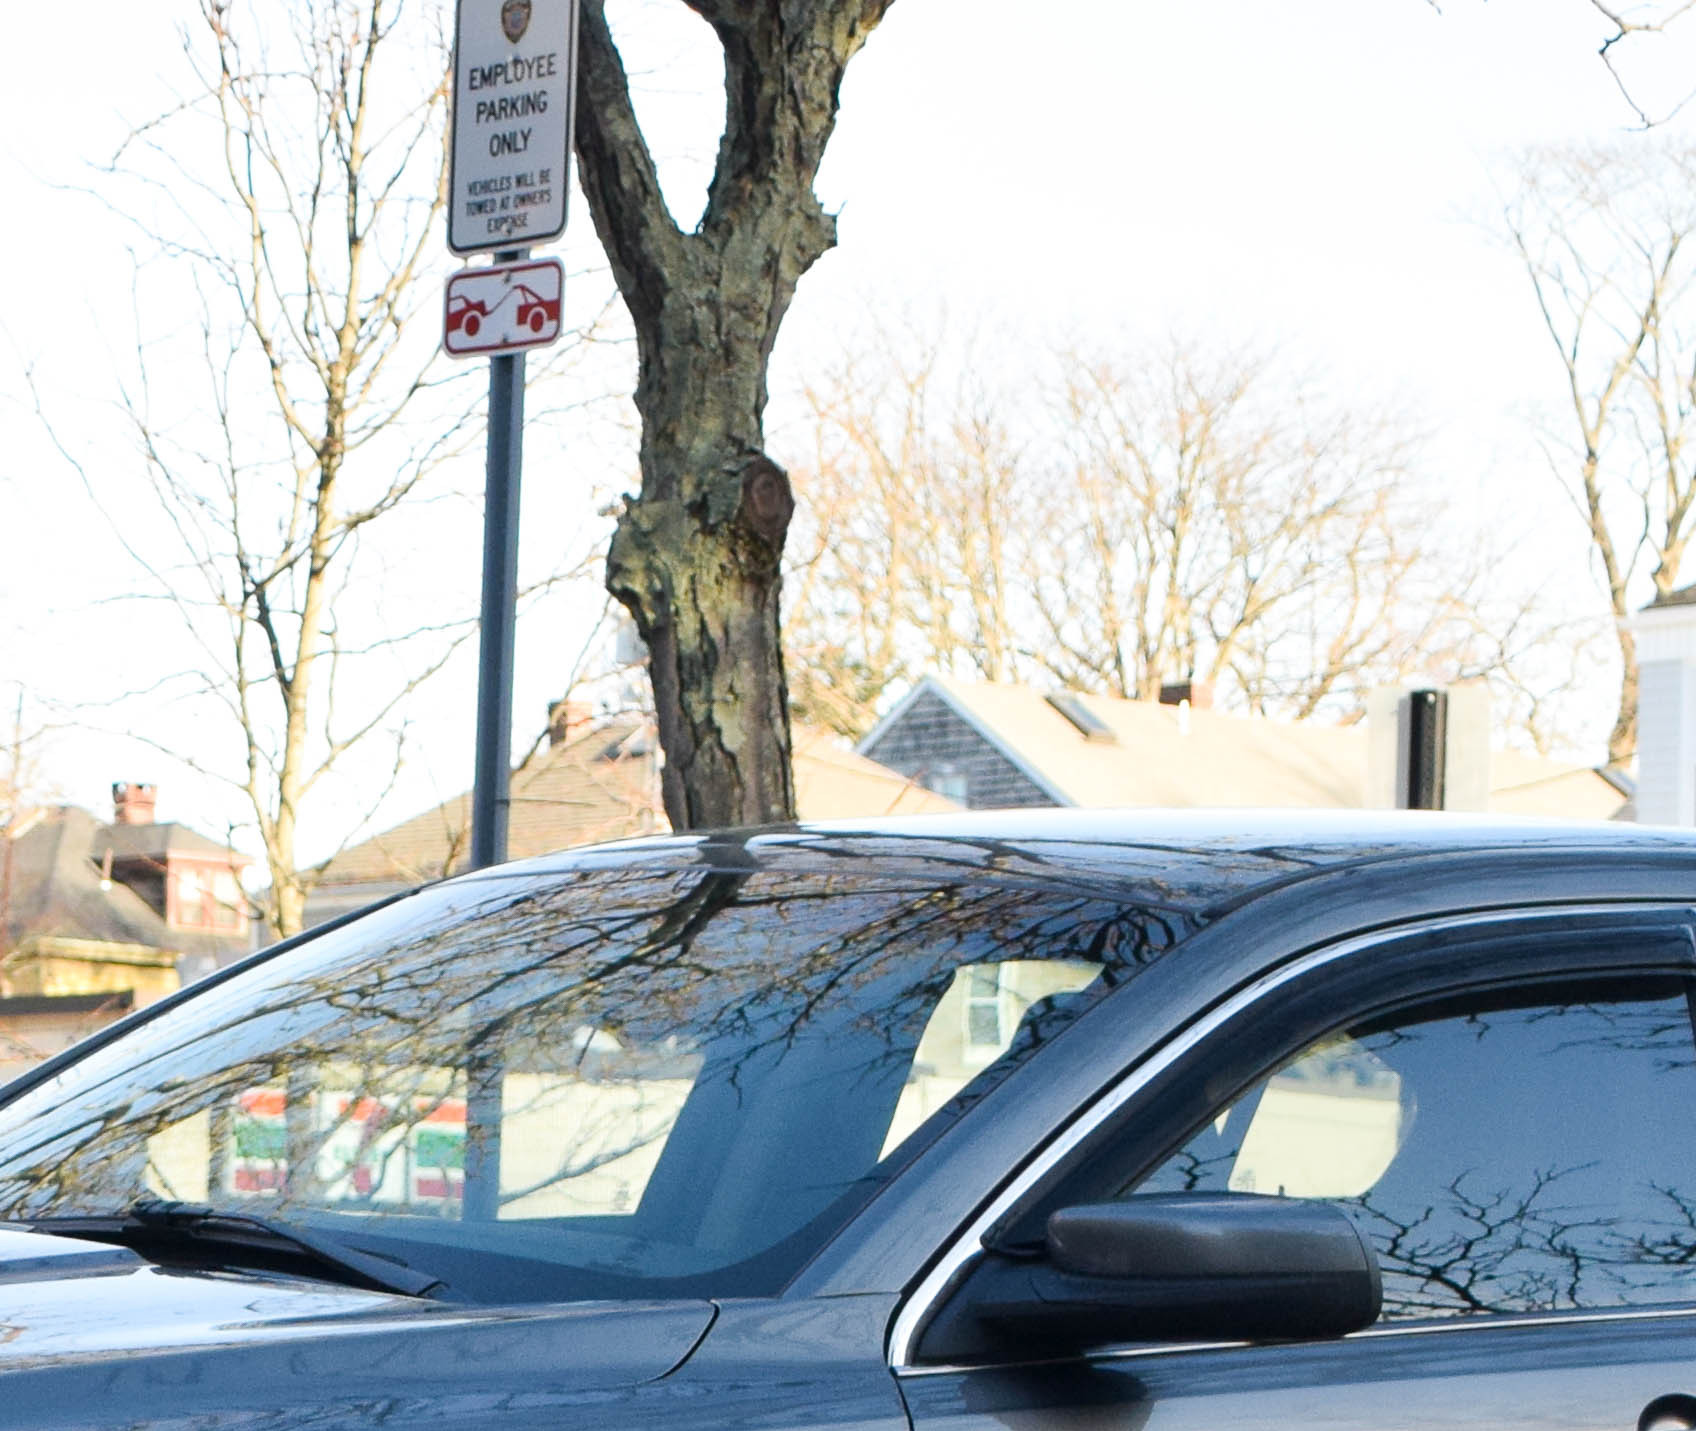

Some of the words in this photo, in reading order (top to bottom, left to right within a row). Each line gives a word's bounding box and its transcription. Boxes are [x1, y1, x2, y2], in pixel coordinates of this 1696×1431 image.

[469, 53, 557, 90] EMPLOYEE
[476, 91, 548, 123] PARKING
[489, 128, 532, 157] ONLY
[467, 176, 512, 196] VEHICLES
[466, 198, 496, 216] TOWED
